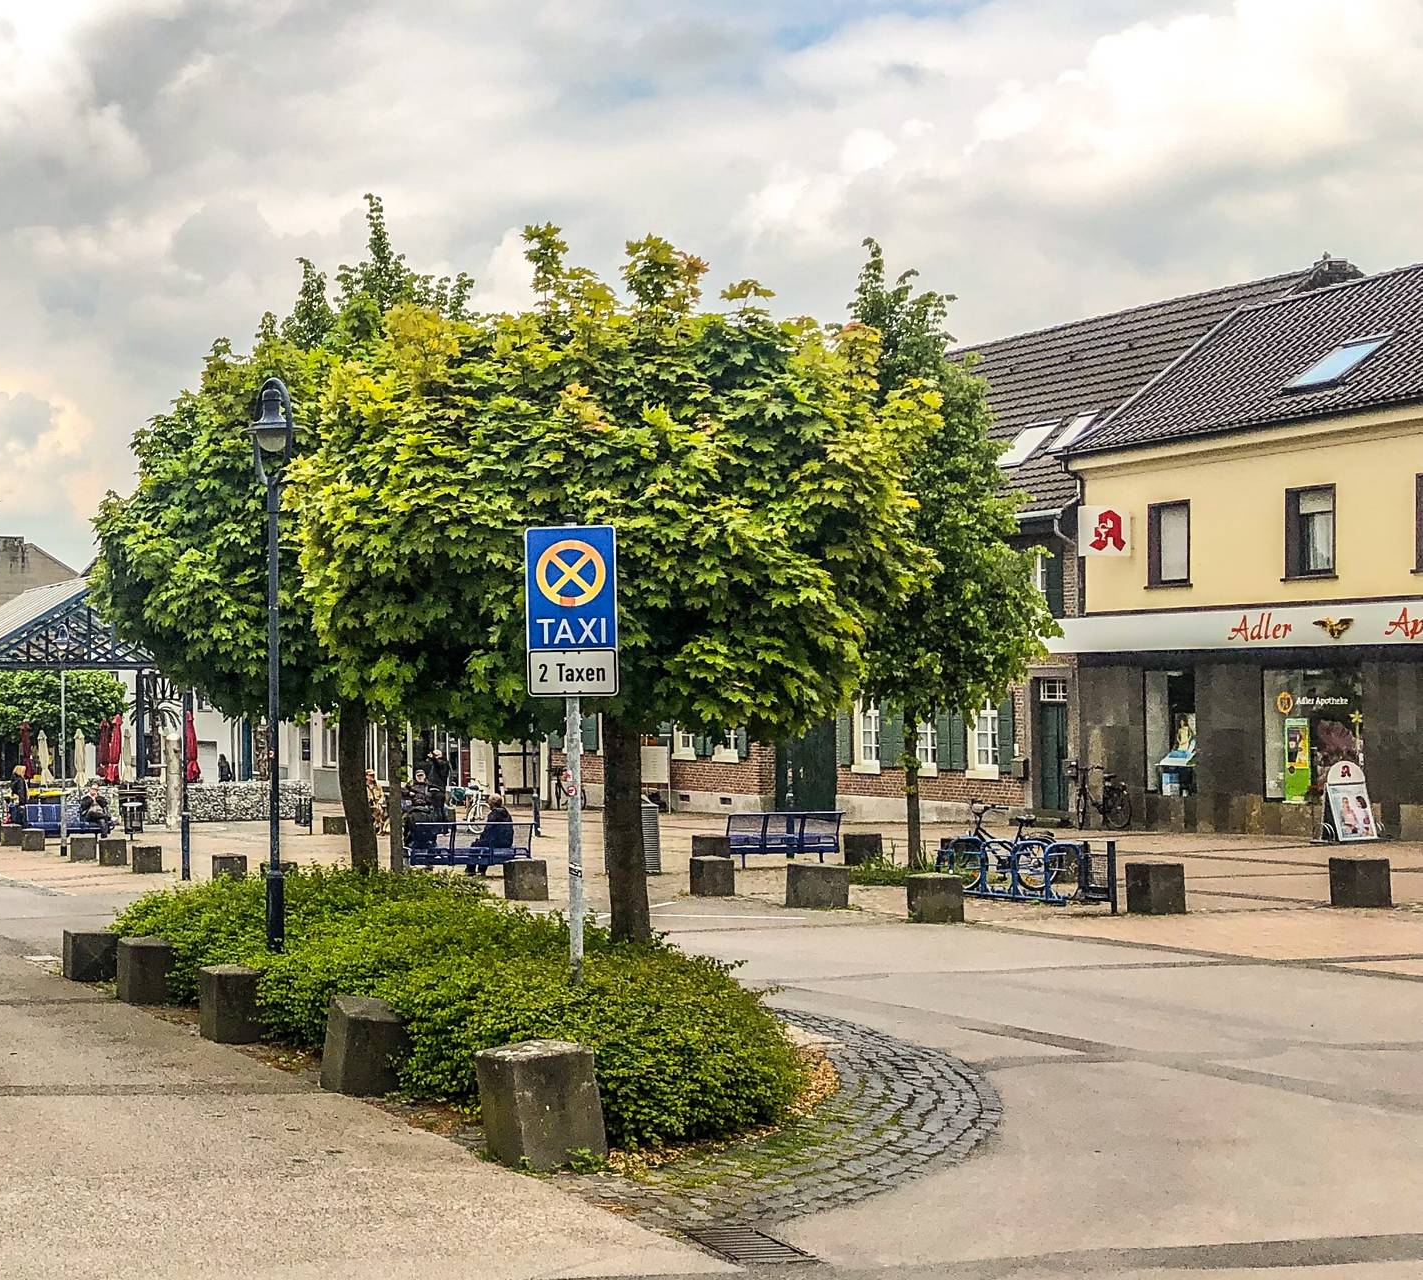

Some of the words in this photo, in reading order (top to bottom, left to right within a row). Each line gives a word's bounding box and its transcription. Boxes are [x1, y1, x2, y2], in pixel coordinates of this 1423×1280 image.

[535, 617, 608, 645] TAXI
[1227, 612, 1293, 642] Adler
[538, 663, 548, 683] 2
[556, 663, 606, 682] Taxen
[1296, 696, 1315, 705] Adler
[1315, 696, 1349, 707] Apotheke
